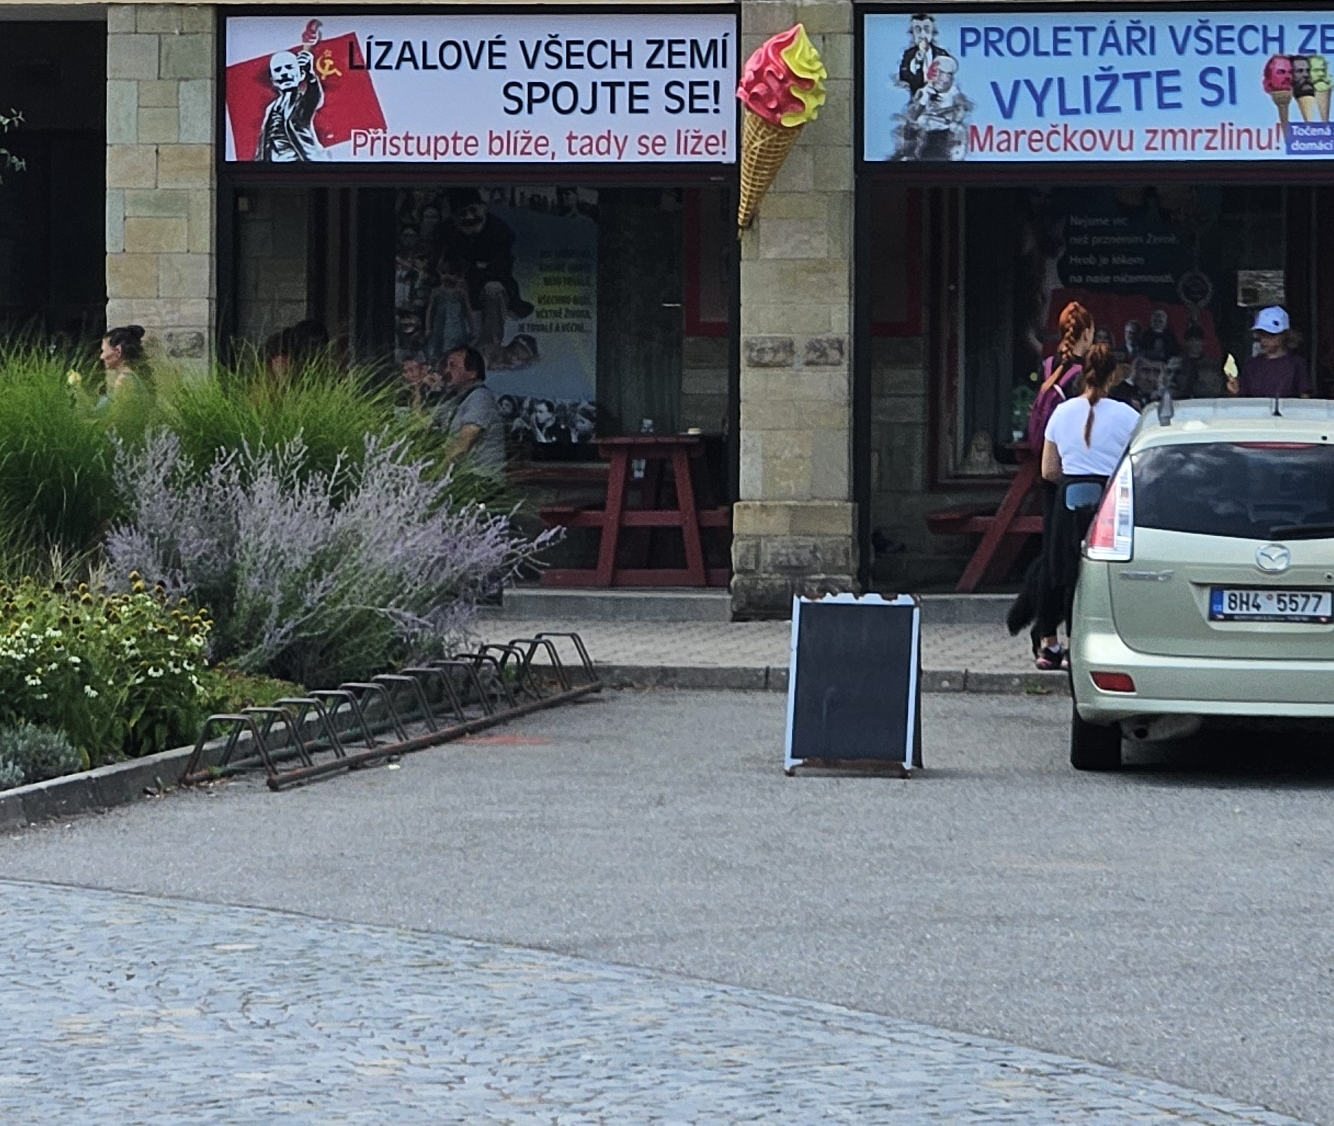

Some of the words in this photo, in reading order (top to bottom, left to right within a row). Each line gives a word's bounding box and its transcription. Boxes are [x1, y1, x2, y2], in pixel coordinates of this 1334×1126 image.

[348, 34, 507, 70] LÍZALOVÉ
[519, 33, 633, 70] VŠECH
[645, 32, 731, 69] ZEMÍ
[960, 19, 1156, 57] PROLETÁŘI
[1168, 19, 1285, 56] VŠECH
[502, 80, 650, 115] SPOJTE
[664, 80, 721, 114] SE!
[989, 65, 1183, 120] VYLIŽTE
[1198, 66, 1238, 107] SI
[352, 129, 480, 160] Přistupte
[488, 129, 556, 160] blíže,
[566, 129, 629, 160] tady
[637, 134, 667, 155] se
[676, 129, 727, 155] líže!
[969, 123, 1134, 153] Marečkovu
[1144, 122, 1282, 151] zmrzlinu!
[1291, 125, 1332, 136] Točená
[1291, 139, 1334, 151] domácí
[1228, 592, 1262, 611] 8H4
[1276, 593, 1323, 612] 5577
